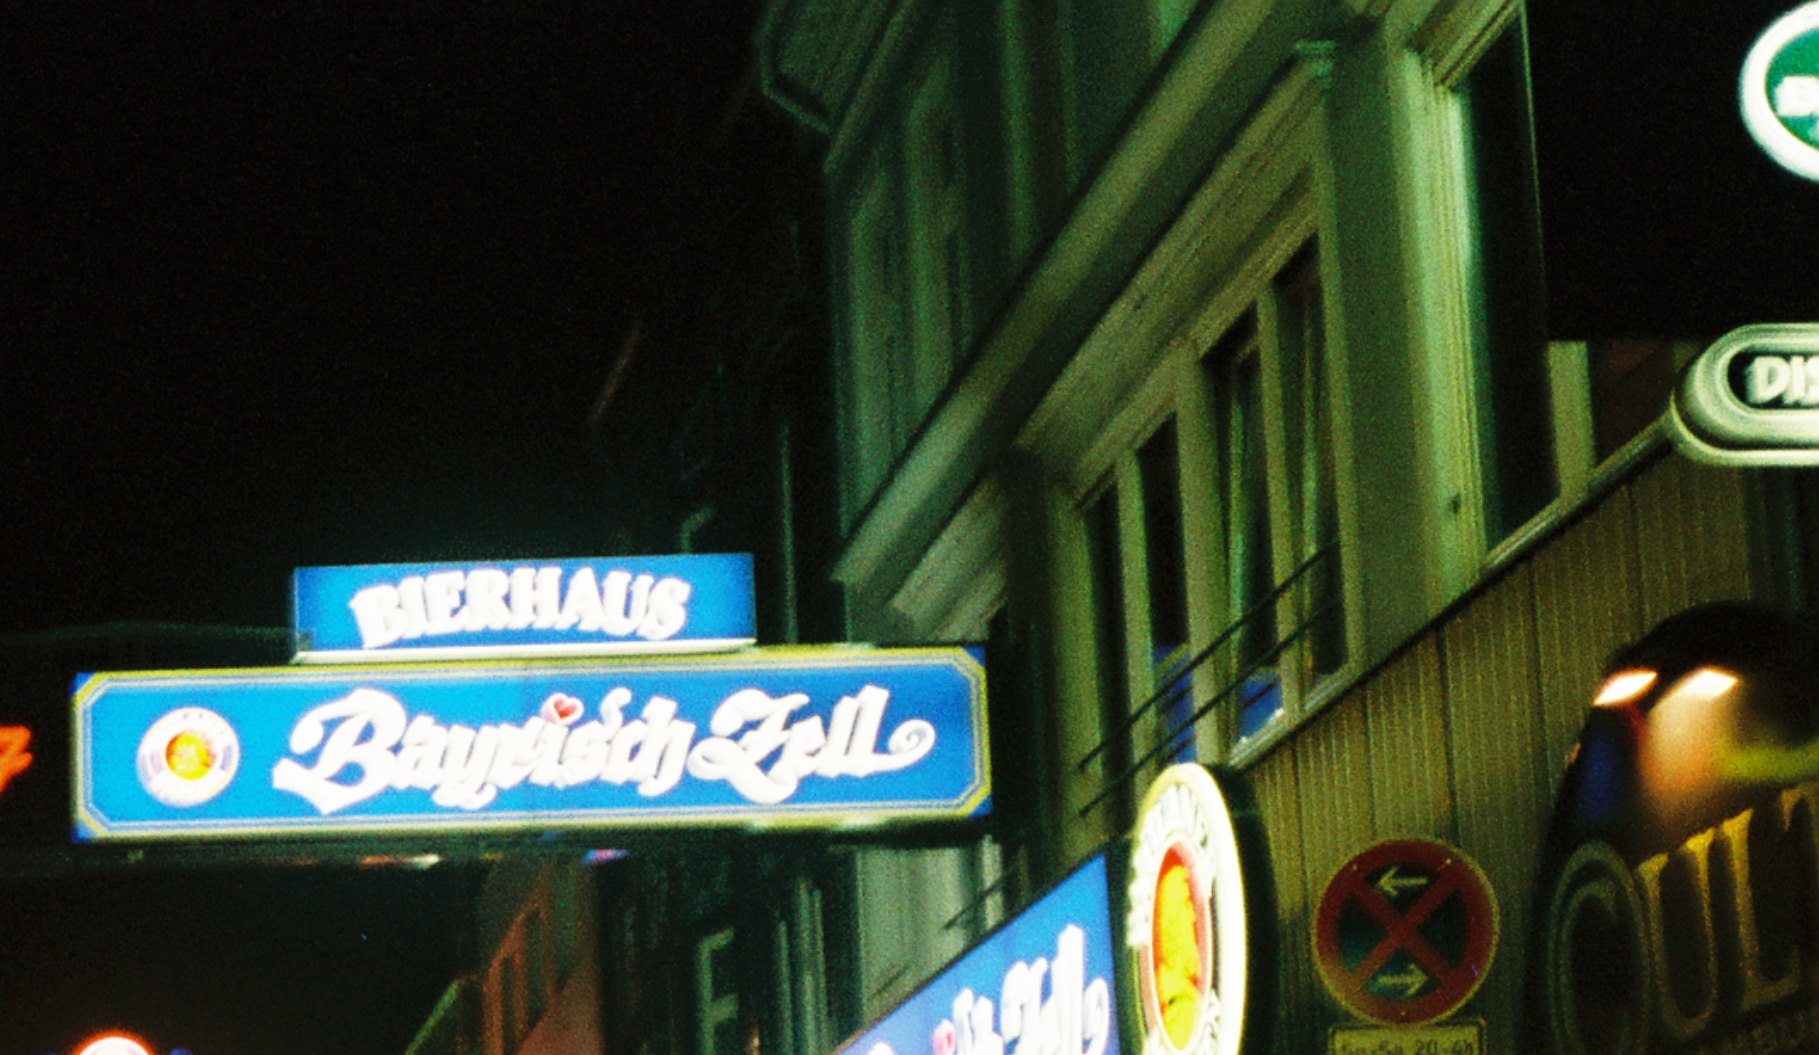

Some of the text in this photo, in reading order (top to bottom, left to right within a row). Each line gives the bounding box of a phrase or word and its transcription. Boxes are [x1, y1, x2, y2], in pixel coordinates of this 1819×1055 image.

[348, 566, 692, 651] BIERHAUS
[272, 686, 694, 815] Bayrisch
[690, 684, 938, 805] Zell
